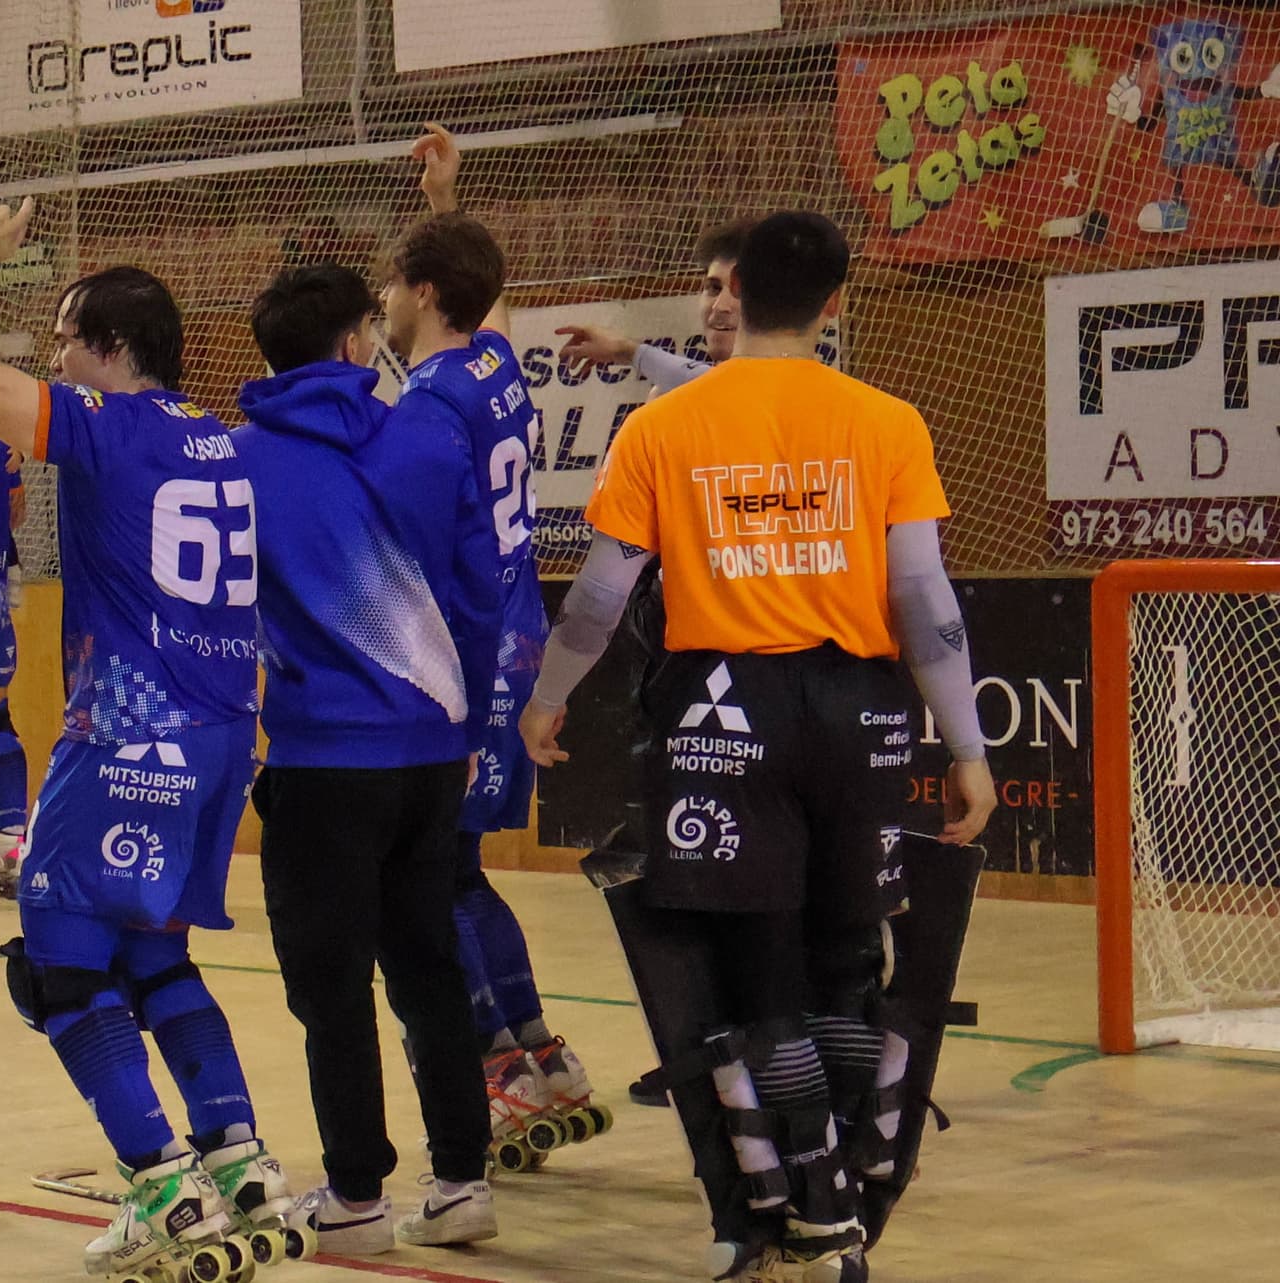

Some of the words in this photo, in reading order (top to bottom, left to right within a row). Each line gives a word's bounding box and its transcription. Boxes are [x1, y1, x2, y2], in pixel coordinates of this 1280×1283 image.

[691, 458, 854, 539] TEAM
[722, 490, 829, 515] REPLIC
[1061, 508, 1124, 547] 973
[1133, 509, 1193, 546] 240
[1205, 507, 1268, 545] 564
[151, 477, 259, 607] 63
[706, 543, 770, 581] PONS
[769, 538, 849, 577] LLEIDA
[666, 735, 765, 762] MITSUBISHI
[97, 763, 198, 792] MITSUBISHI
[670, 754, 747, 777] MOTORS
[107, 783, 182, 807] MOTORS
